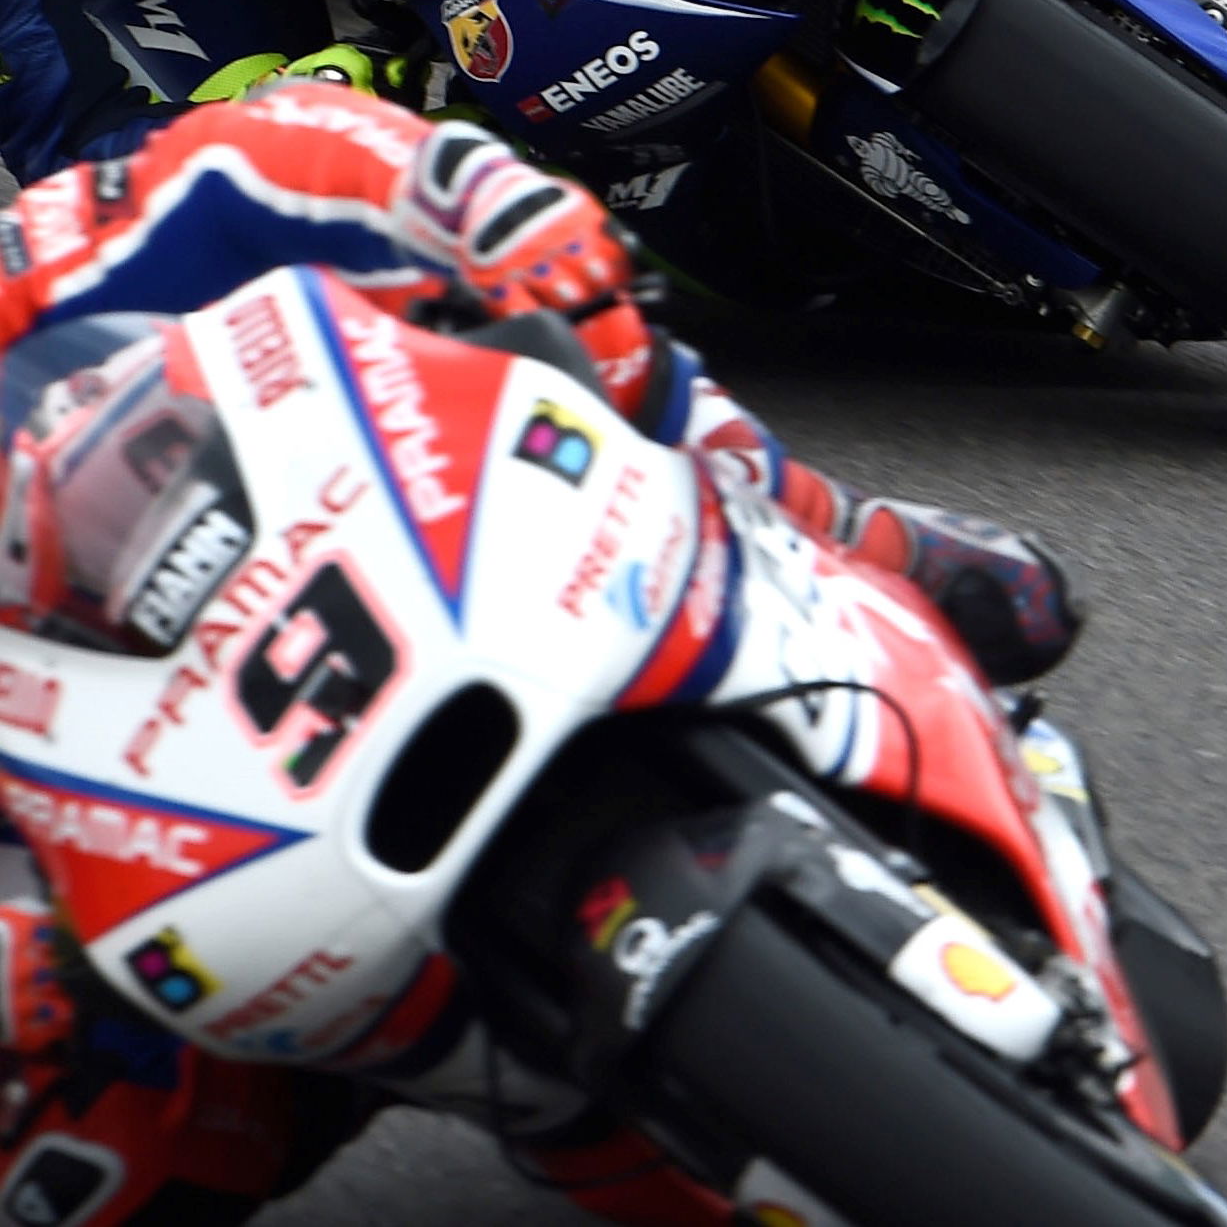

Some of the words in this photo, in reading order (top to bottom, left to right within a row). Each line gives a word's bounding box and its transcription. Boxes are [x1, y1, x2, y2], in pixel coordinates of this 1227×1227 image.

[541, 30, 660, 113] ENEOS
[580, 67, 706, 132] YAMALUBE
[342, 316, 467, 523] PRAMAC
[234, 560, 398, 790] 9
